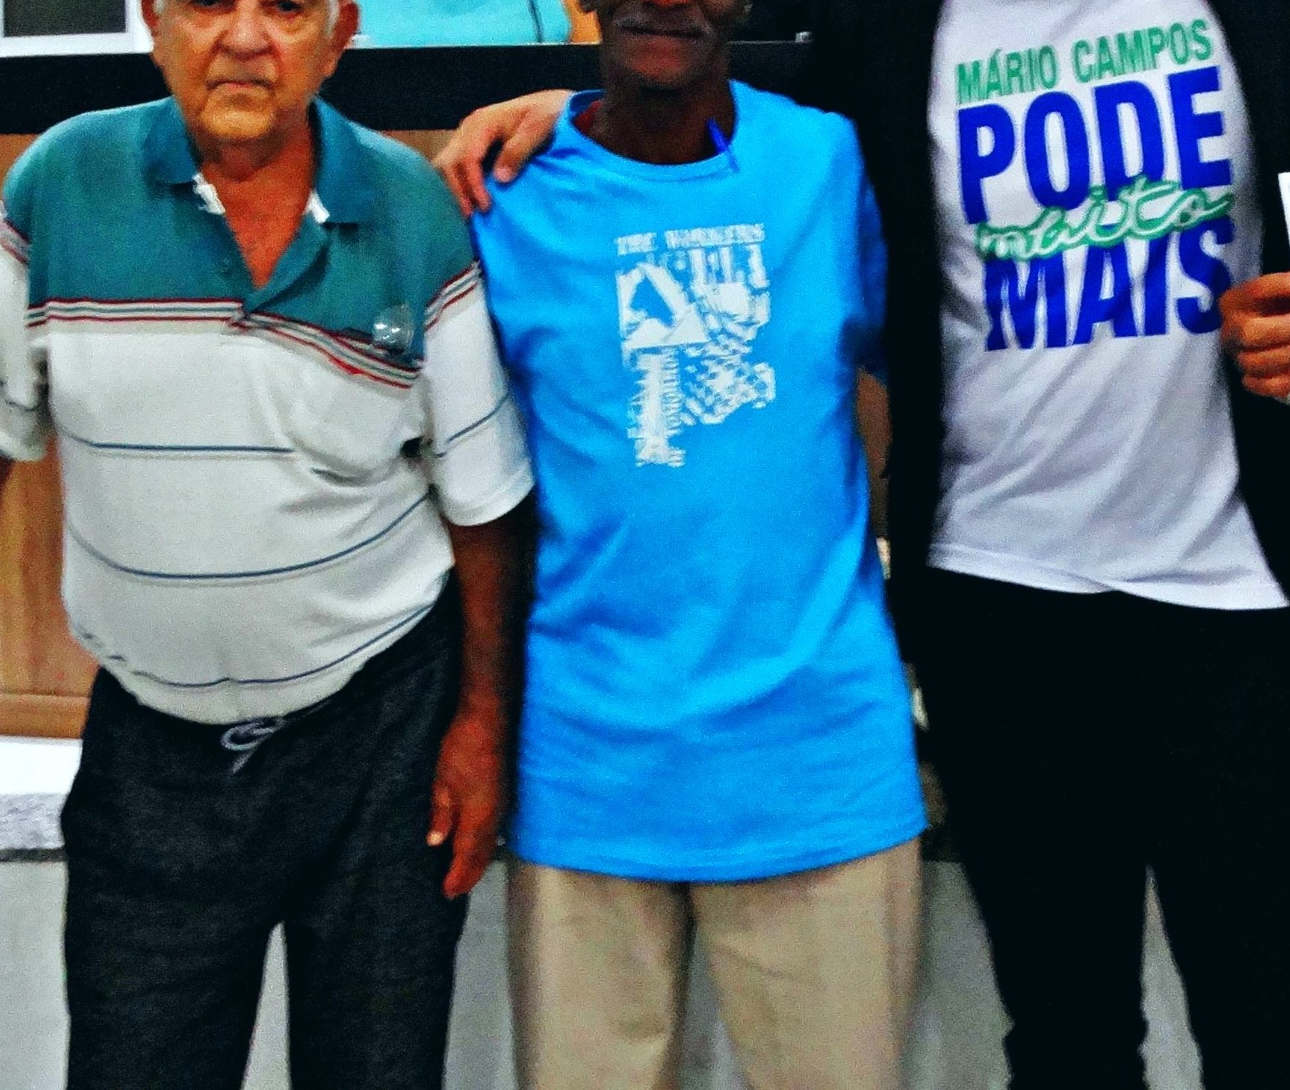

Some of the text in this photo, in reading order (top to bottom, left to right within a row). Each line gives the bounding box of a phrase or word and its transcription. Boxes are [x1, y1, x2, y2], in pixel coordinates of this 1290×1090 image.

[956, 20, 1211, 105] MÁRIO CAMPOS
[957, 65, 1232, 225] PODE
[983, 215, 1234, 352] MAIS
